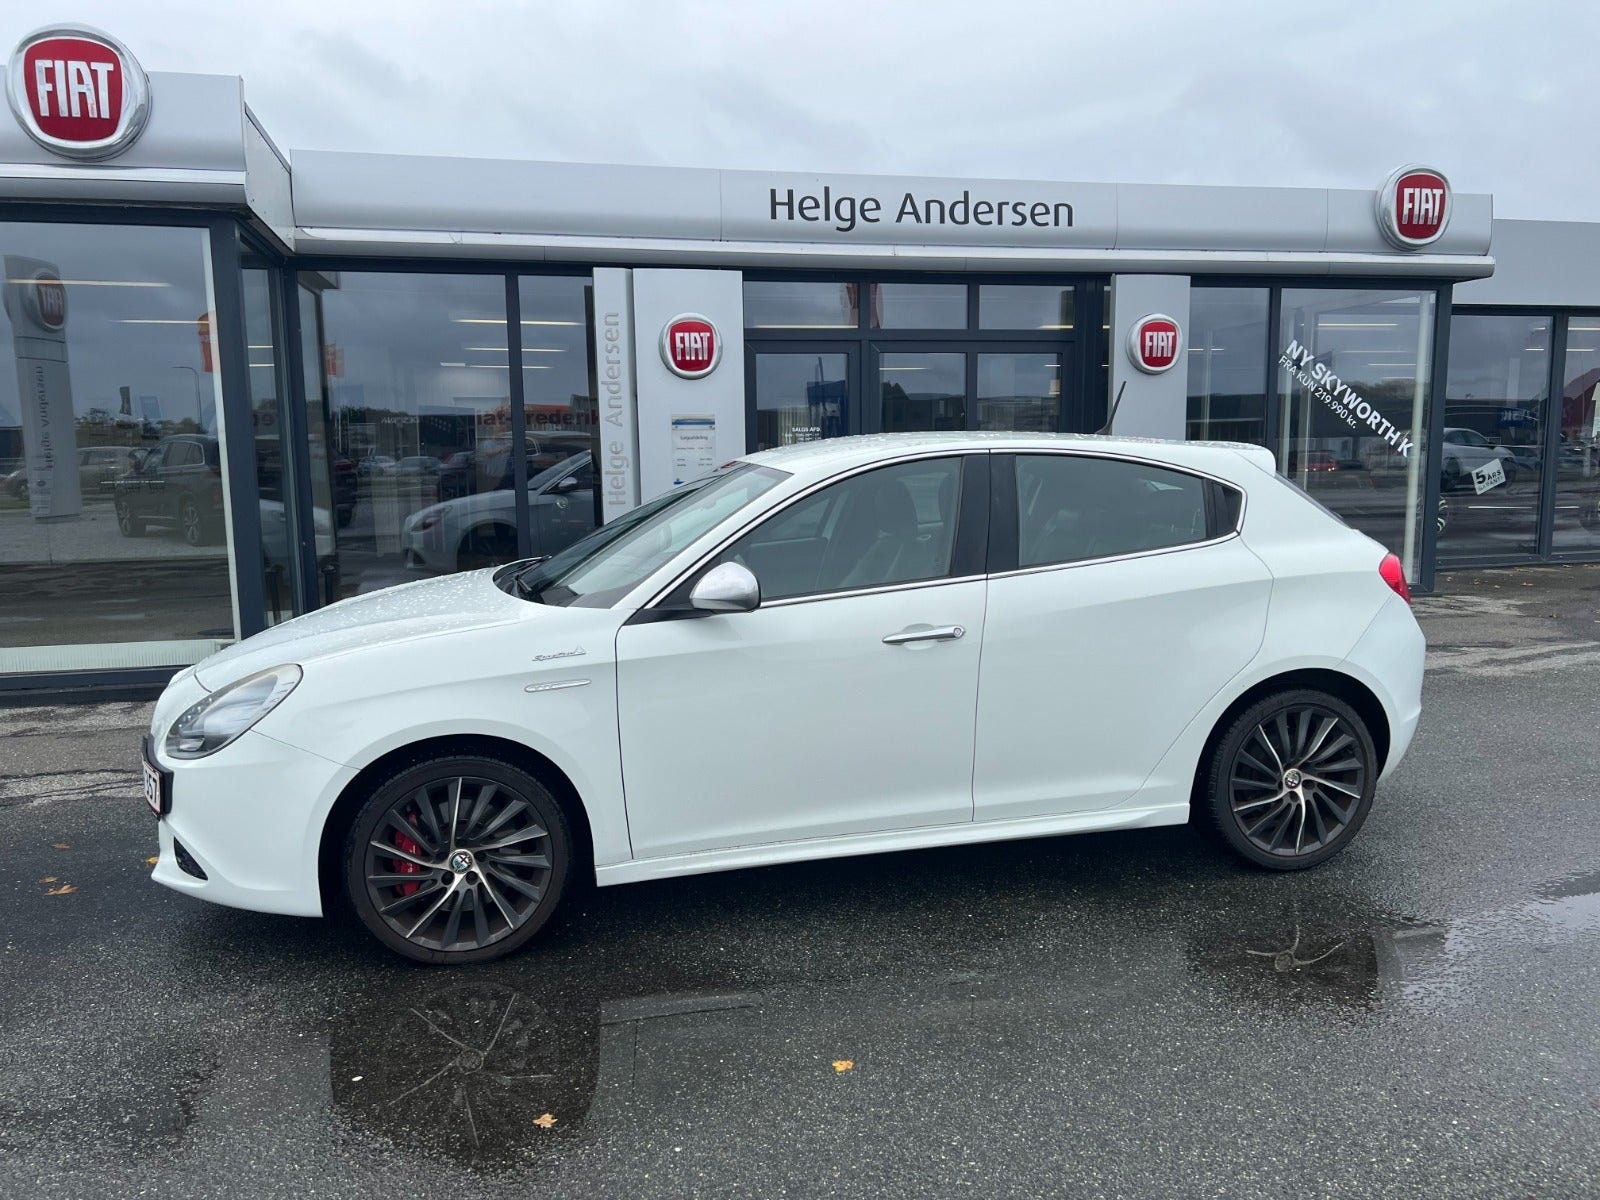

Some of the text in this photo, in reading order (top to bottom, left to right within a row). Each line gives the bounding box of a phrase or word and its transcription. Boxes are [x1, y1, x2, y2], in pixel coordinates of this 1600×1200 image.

[35, 59, 114, 119] FIAT
[770, 186, 1074, 232] Helge Andersen
[1402, 187, 1444, 225] FIAT
[675, 332, 710, 361] FIAT
[1145, 331, 1175, 358] FIAT
[601, 312, 629, 506] Helge Andersen
[1279, 355, 1298, 376] FRA
[1296, 371, 1318, 392] KUN
[1314, 387, 1348, 419] 219.990
[1286, 340, 1414, 457] NY SKYWORTH K
[1475, 470, 1487, 485] 5
